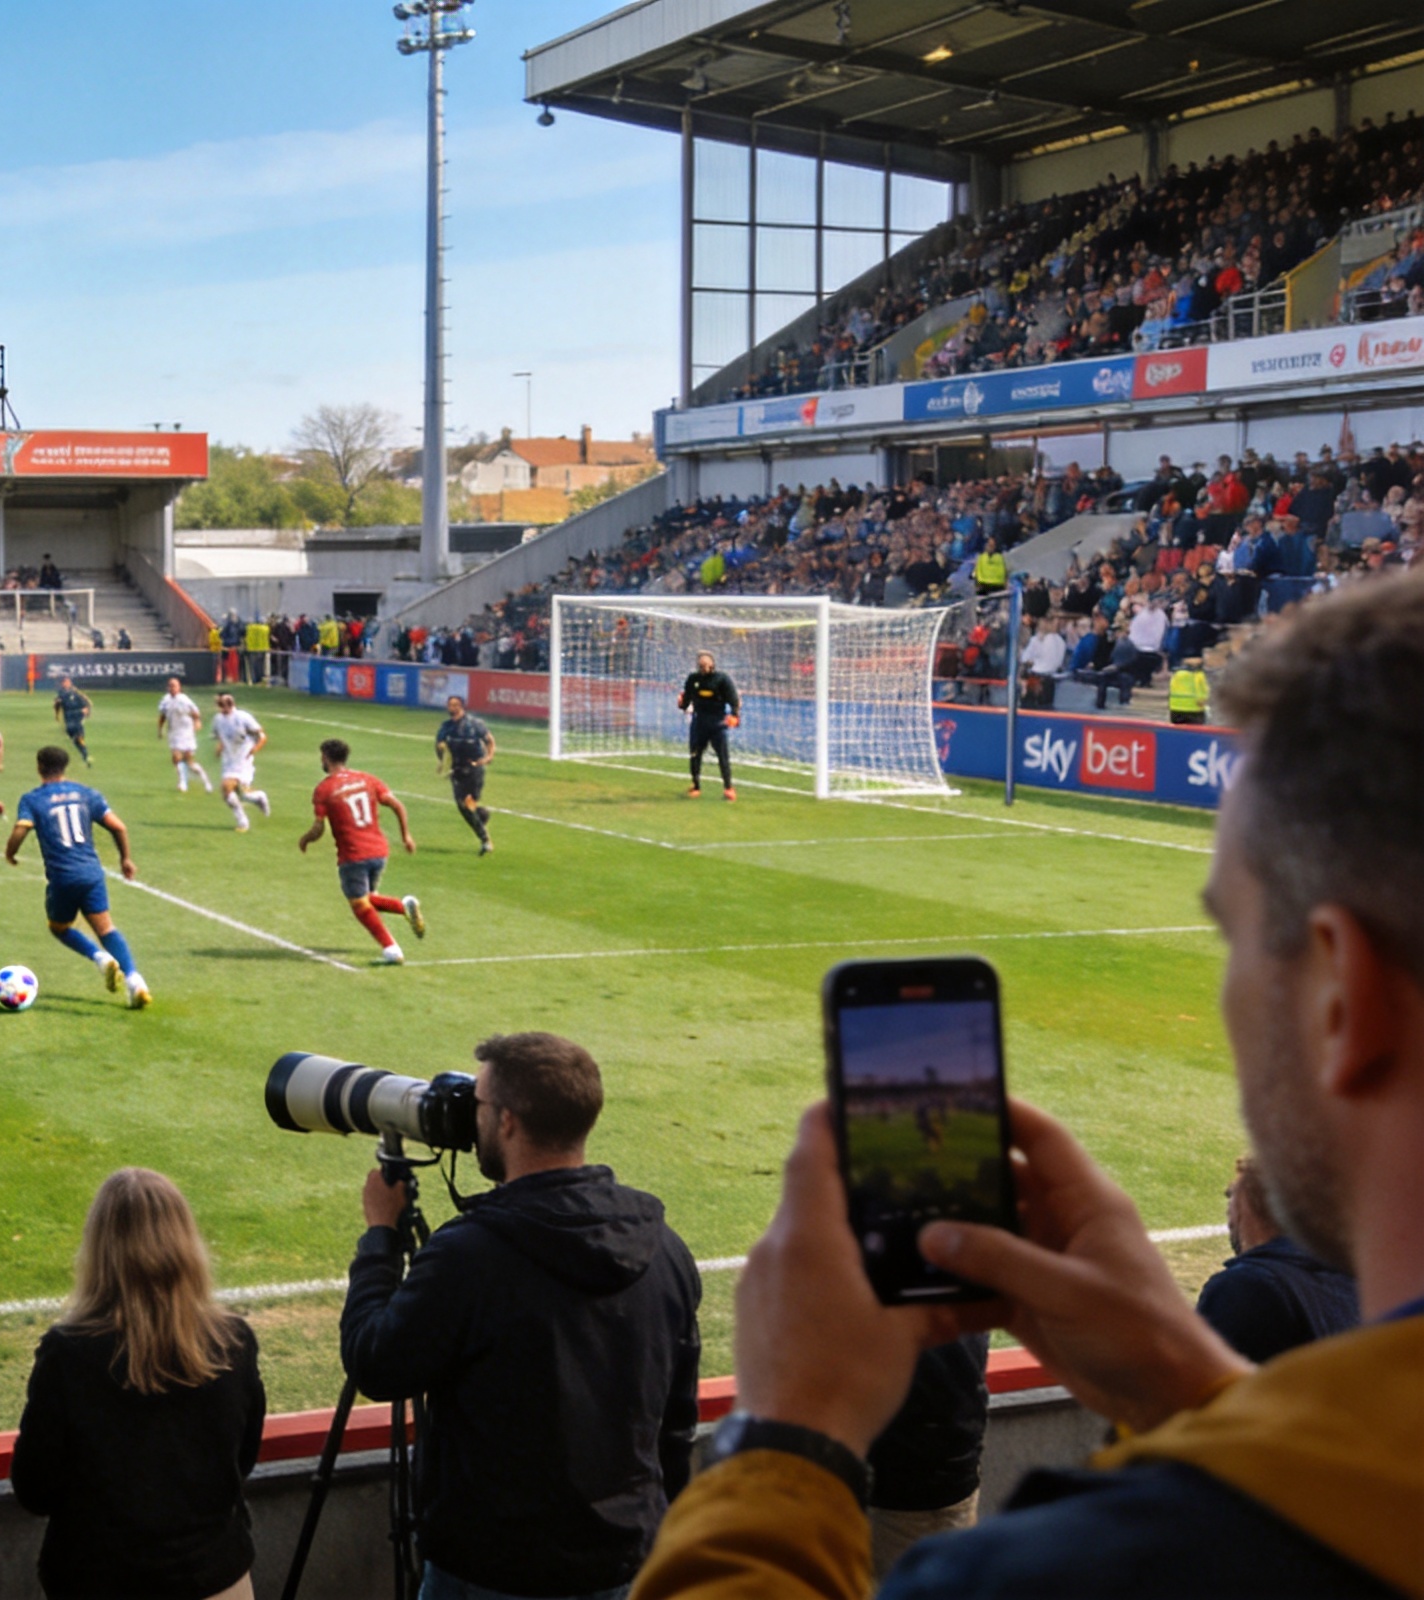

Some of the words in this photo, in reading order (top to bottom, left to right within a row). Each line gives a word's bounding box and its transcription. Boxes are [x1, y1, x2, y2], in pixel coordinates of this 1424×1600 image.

[1023, 728, 1077, 782] sky
[1086, 730, 1146, 778] bet
[48, 803, 85, 848] 11
